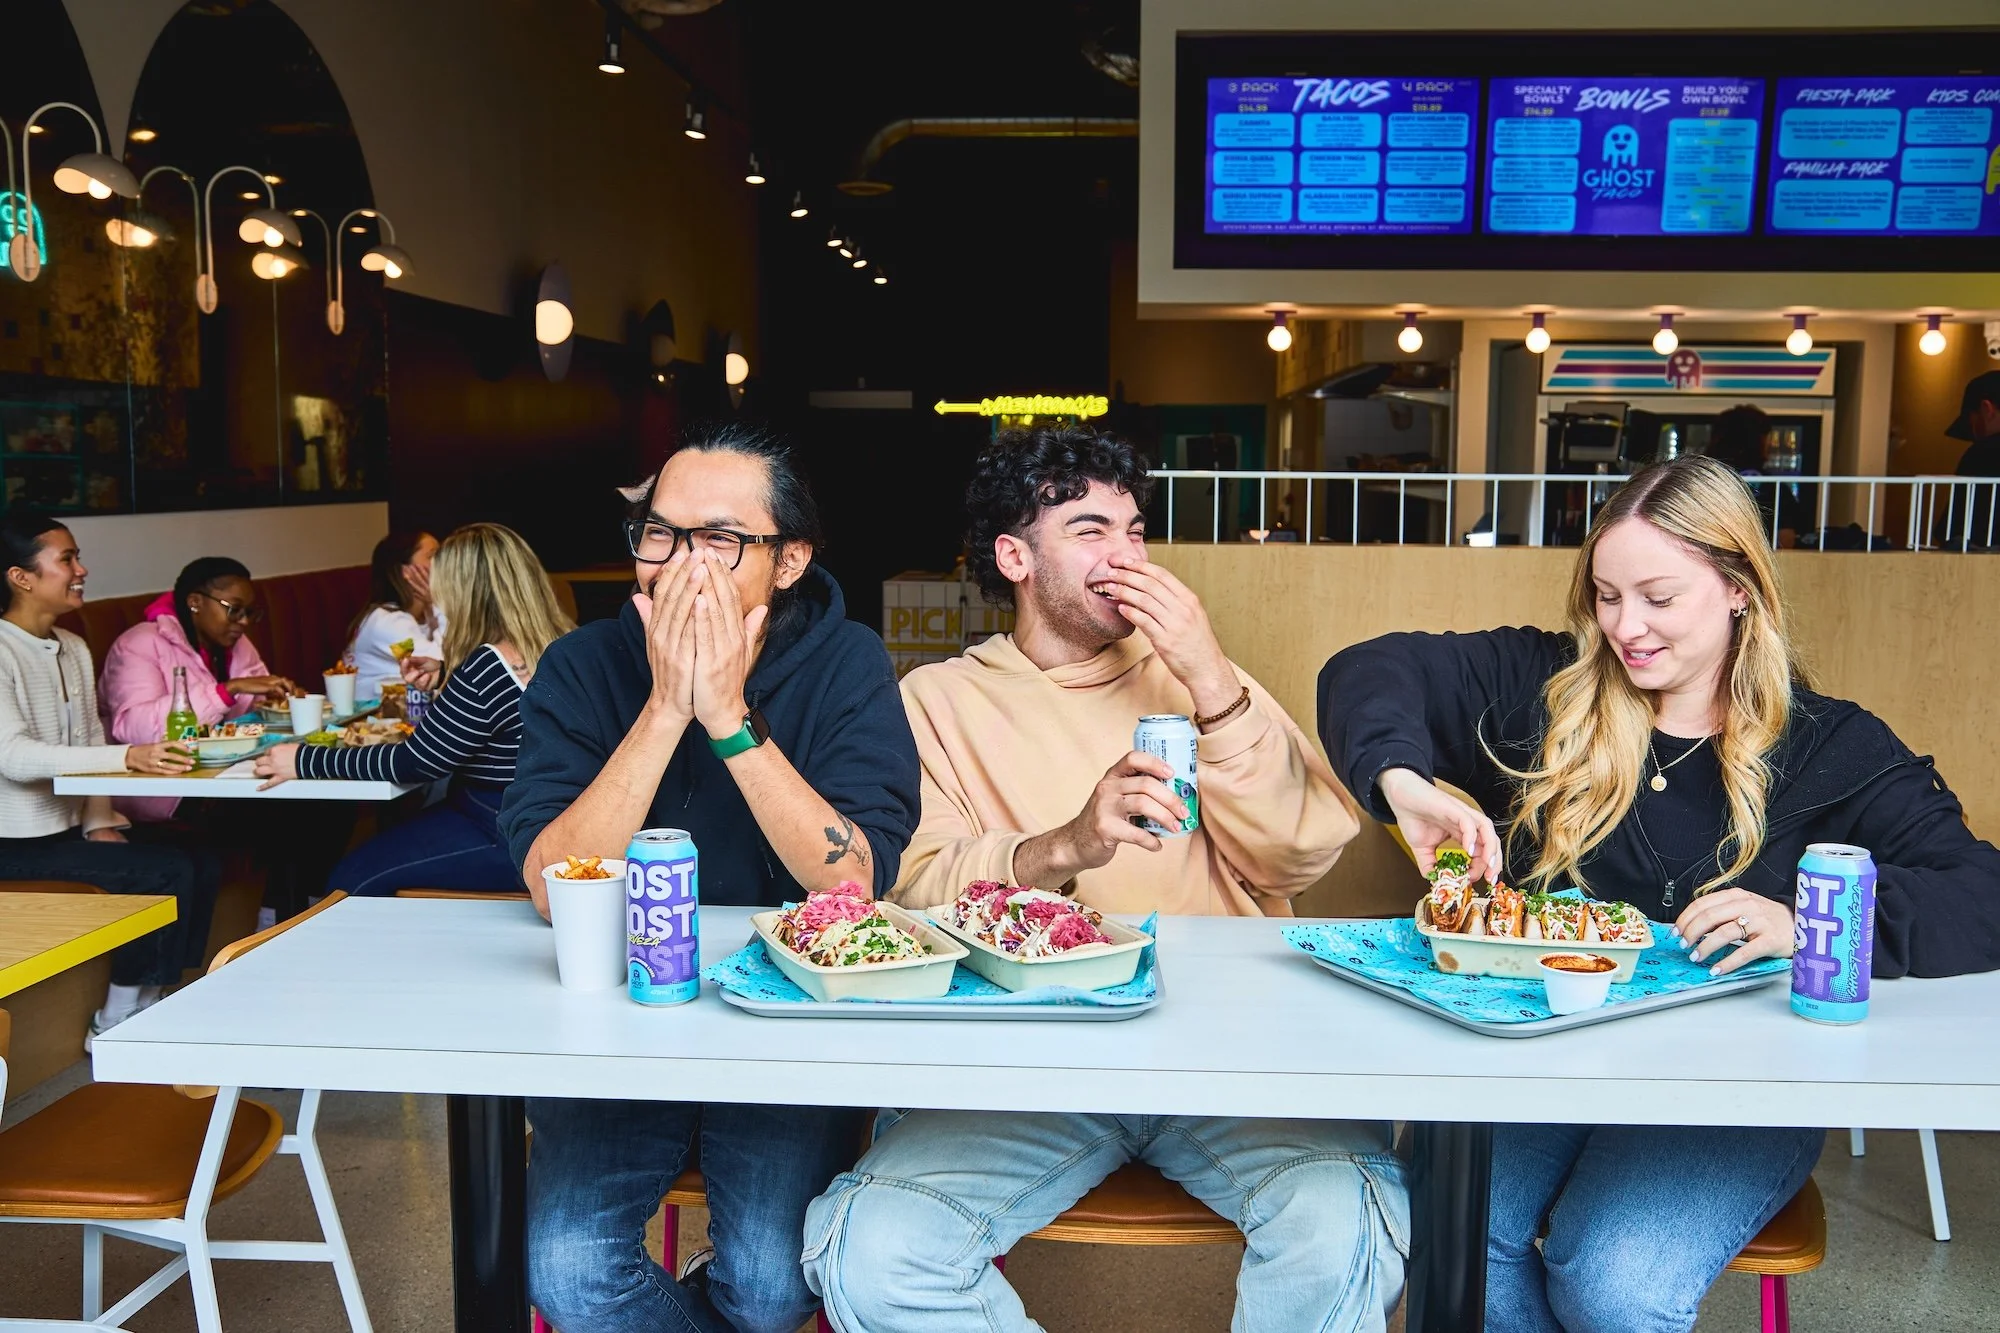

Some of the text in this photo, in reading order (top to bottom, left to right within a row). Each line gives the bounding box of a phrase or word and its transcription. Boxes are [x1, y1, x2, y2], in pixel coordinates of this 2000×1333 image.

[1241, 82, 1280, 93] PACK
[1293, 78, 1391, 112] TACOS
[1401, 81, 1413, 92] 4
[1416, 81, 1454, 92] PACK
[1514, 85, 1572, 95] SPECIALTY
[1683, 85, 1750, 95] BUILD YOUR
[1523, 95, 1564, 104] BOWLS
[1574, 87, 1671, 113] BOWLS
[1681, 95, 1747, 104] OWN BOWL
[1796, 88, 1896, 106] FIESTA PACK
[1926, 88, 1969, 104] KIDS
[1583, 168, 1655, 188] GHOST
[1847, 161, 1889, 179] PACK
[890, 607, 963, 639] PICK
[627, 862, 695, 901] OST
[1848, 883, 1864, 949] CERVEZA
